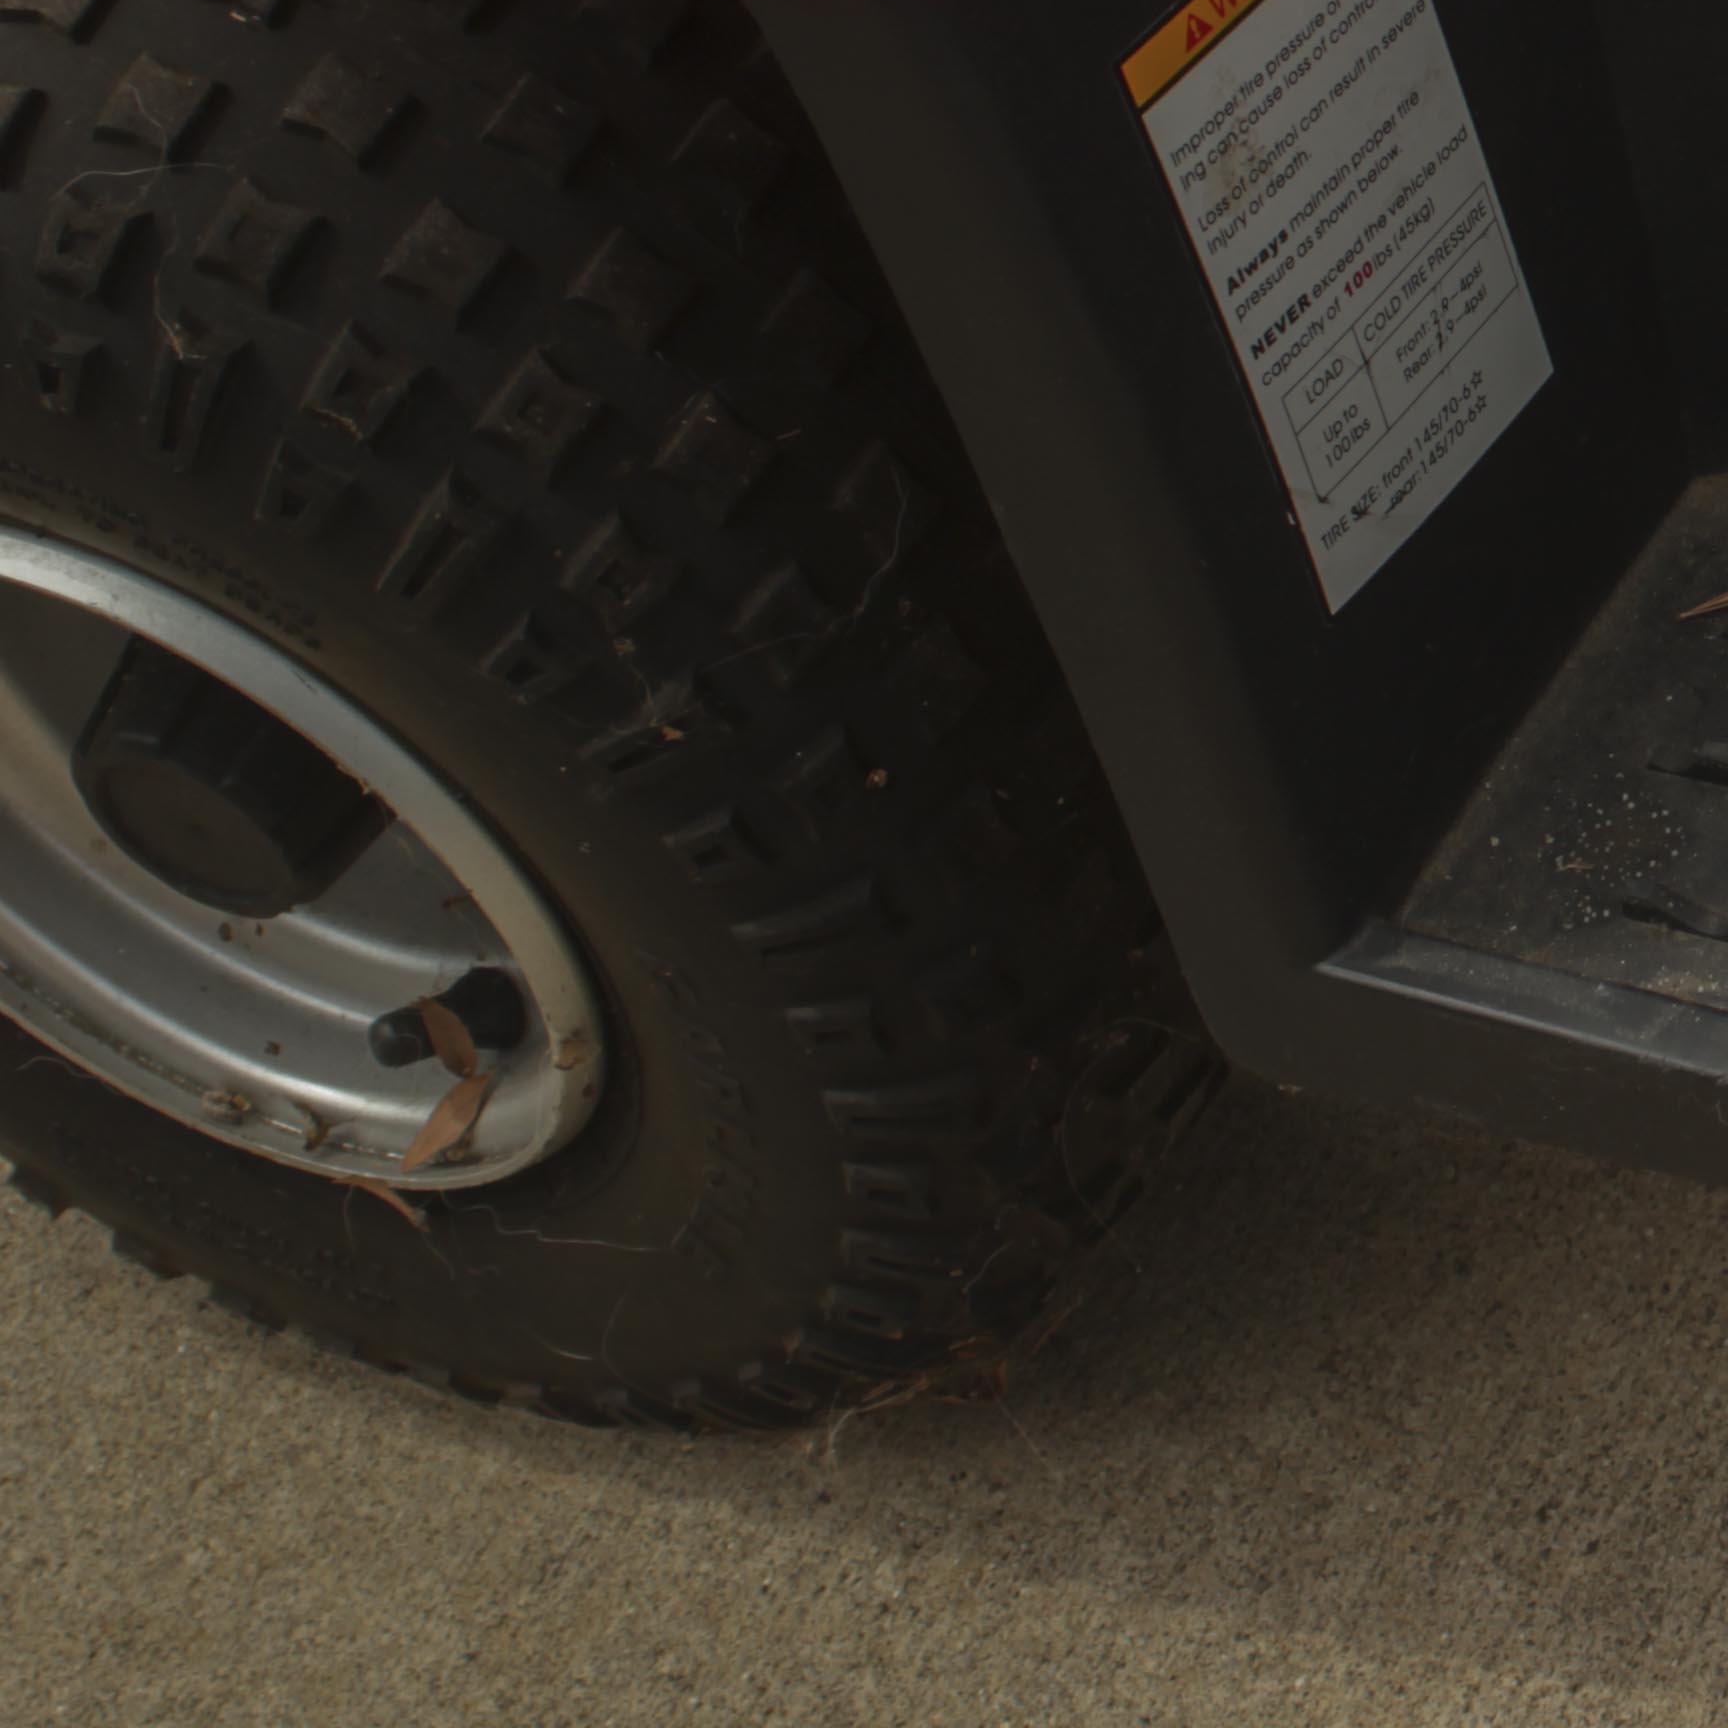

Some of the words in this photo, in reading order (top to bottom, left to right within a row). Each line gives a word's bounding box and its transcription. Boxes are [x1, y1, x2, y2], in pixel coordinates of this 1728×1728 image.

[1170, 95, 1238, 166] Improper
[1238, 72, 1264, 100] tire
[1265, 12, 1325, 78] pressure
[1197, 196, 1230, 232] Loss
[1230, 175, 1246, 200] of
[1248, 125, 1298, 184] control
[1299, 98, 1328, 132] can
[1328, 56, 1366, 101] result
[1365, 44, 1381, 64] in
[1207, 130, 1238, 165] can
[1236, 85, 1282, 134] cause
[1283, 56, 1311, 88] loss
[1312, 36, 1327, 61] of
[1227, 229, 1288, 295] Always
[1289, 164, 1350, 231] maintain
[1351, 114, 1396, 170] proper
[1396, 90, 1419, 118] tire
[1235, 255, 1294, 322] pressure
[1296, 234, 1314, 258] as
[1314, 189, 1357, 239] shown
[1356, 144, 1398, 193] below.
[1248, 192, 1264, 215] or
[1265, 151, 1310, 198] death.
[1250, 293, 1311, 359] NEVER
[1311, 236, 1364, 298] exceed
[1363, 213, 1387, 242] the
[1387, 161, 1436, 215] vehicle
[1436, 123, 1468, 164] load
[1363, 295, 1401, 342] COLD
[1400, 264, 1427, 299] TIRE
[1427, 199, 1486, 270] PRESSURE
[1261, 316, 1324, 386] capacity
[1326, 295, 1341, 320] of
[1305, 357, 1343, 404] LOAD
[1395, 321, 1430, 362] Front:
[1320, 514, 1350, 549] TIRE
[1381, 447, 1413, 488] front
